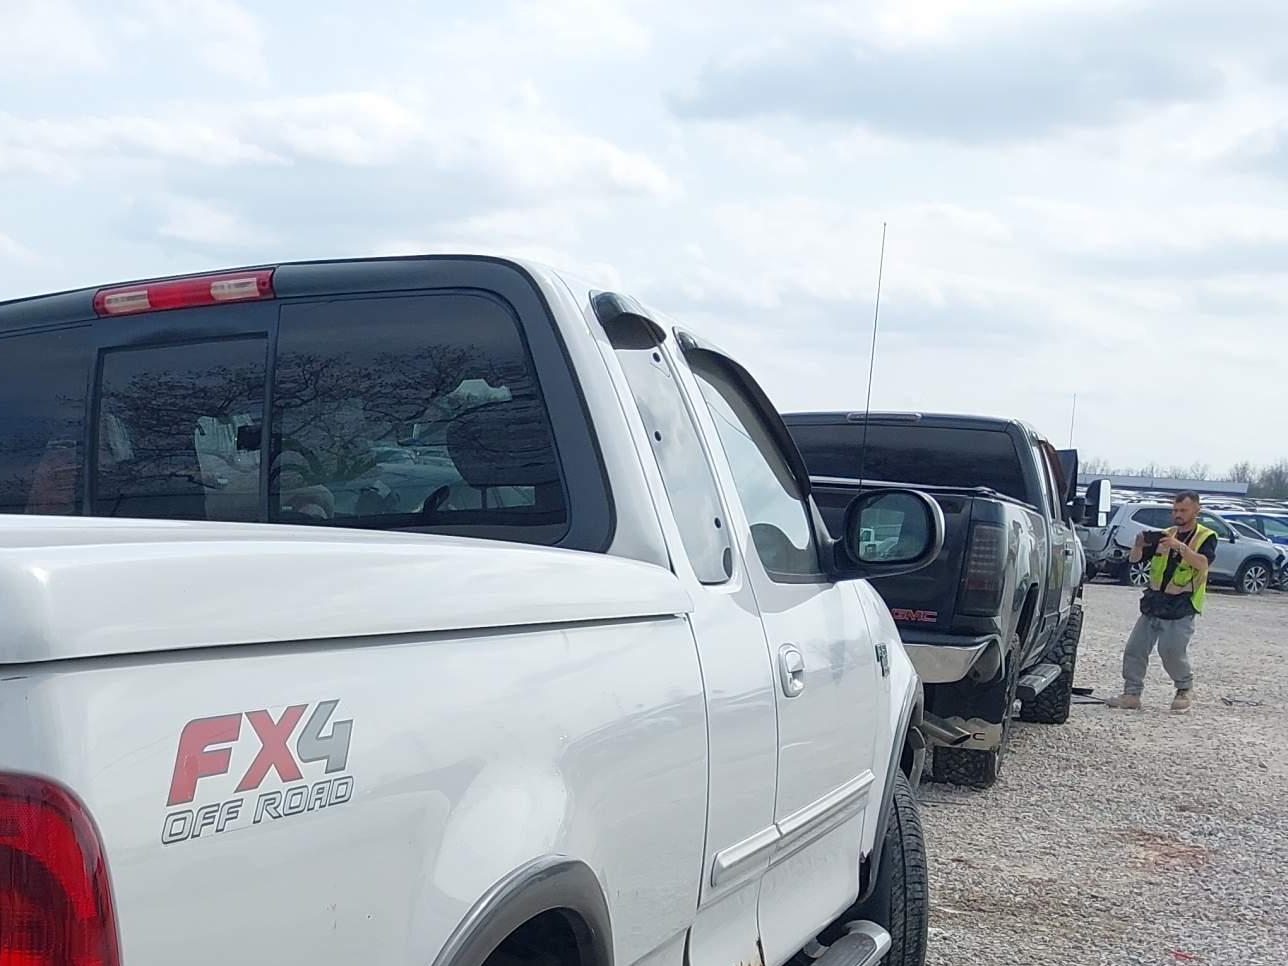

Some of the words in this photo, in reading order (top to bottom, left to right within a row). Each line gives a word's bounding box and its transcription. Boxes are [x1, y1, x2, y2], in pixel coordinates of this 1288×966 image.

[891, 607, 938, 622] GMC
[166, 698, 354, 807] FX4
[162, 798, 244, 845] OFF
[252, 775, 354, 825] ROAD
